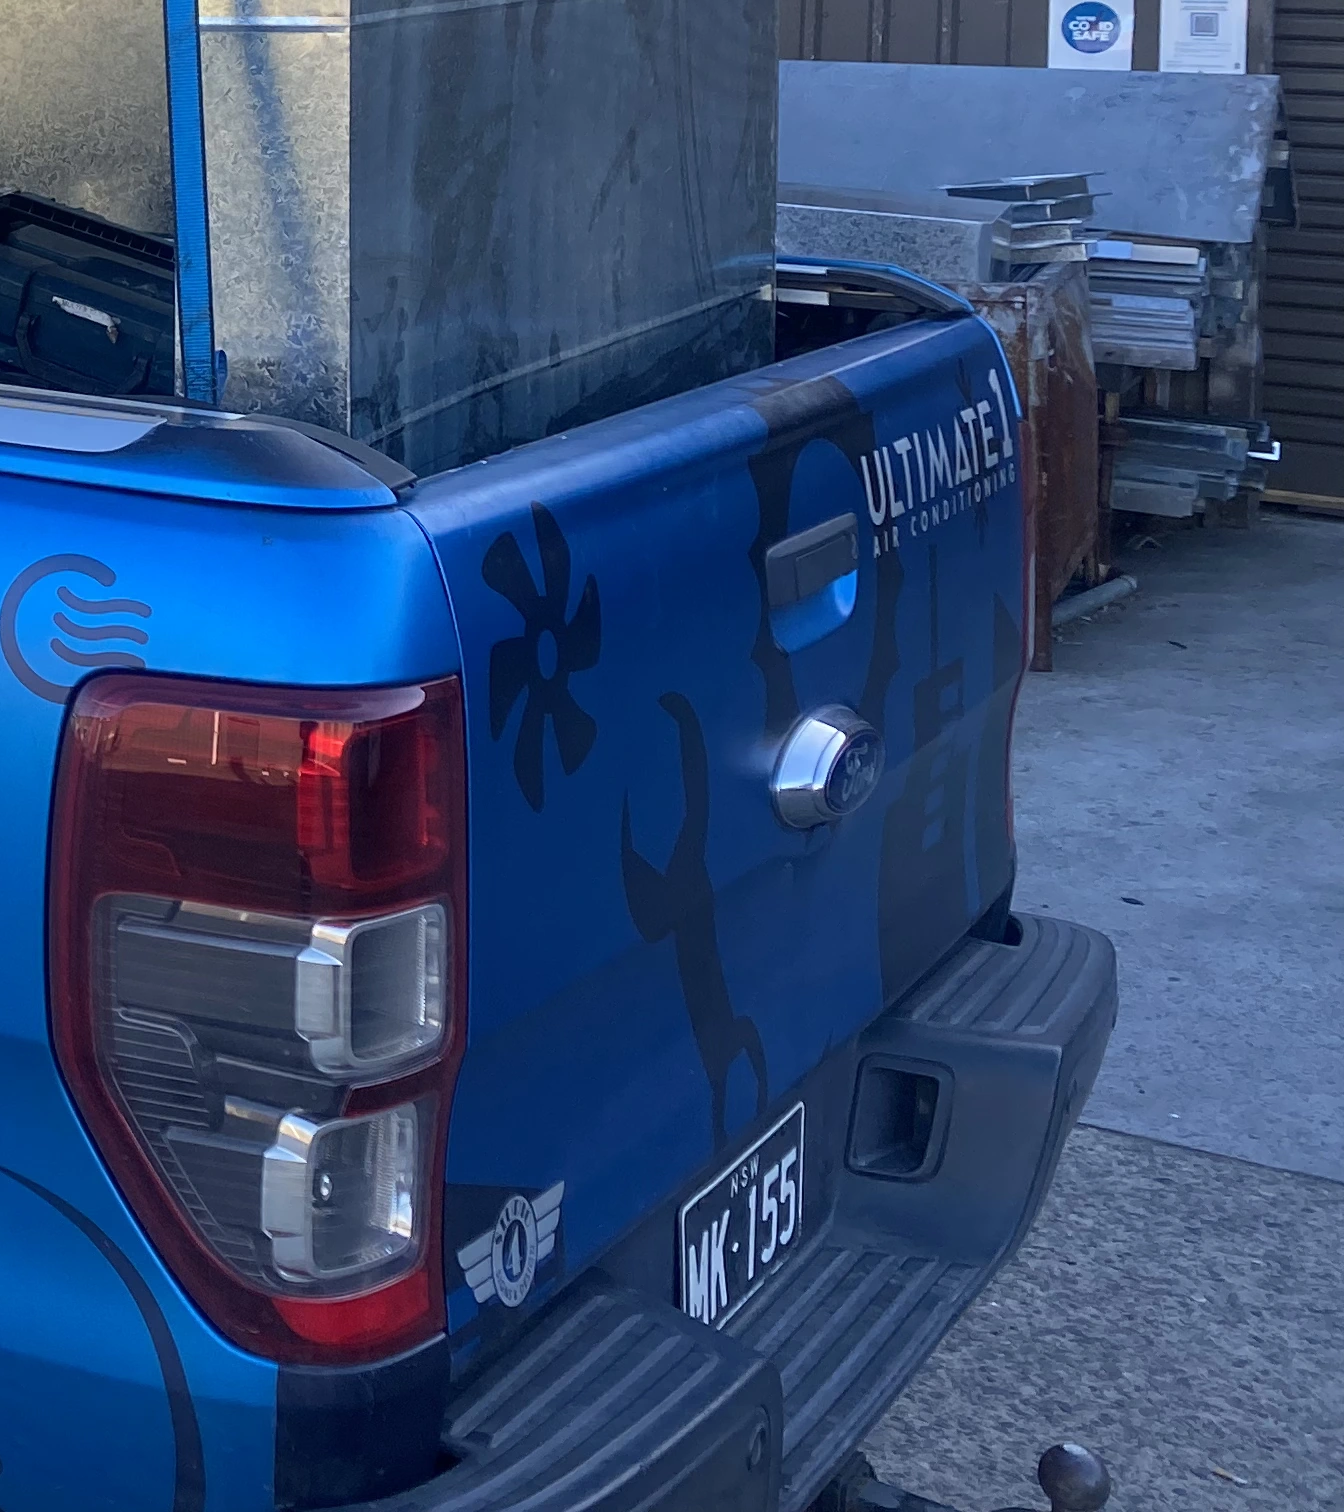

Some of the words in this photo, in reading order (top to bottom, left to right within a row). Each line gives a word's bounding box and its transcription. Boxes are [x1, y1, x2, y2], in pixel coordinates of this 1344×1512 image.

[1072, 30, 1110, 42] SAFE
[873, 525, 900, 559] AIR
[910, 462, 1016, 537] CONDITIONING
[730, 1153, 760, 1198] NSW
